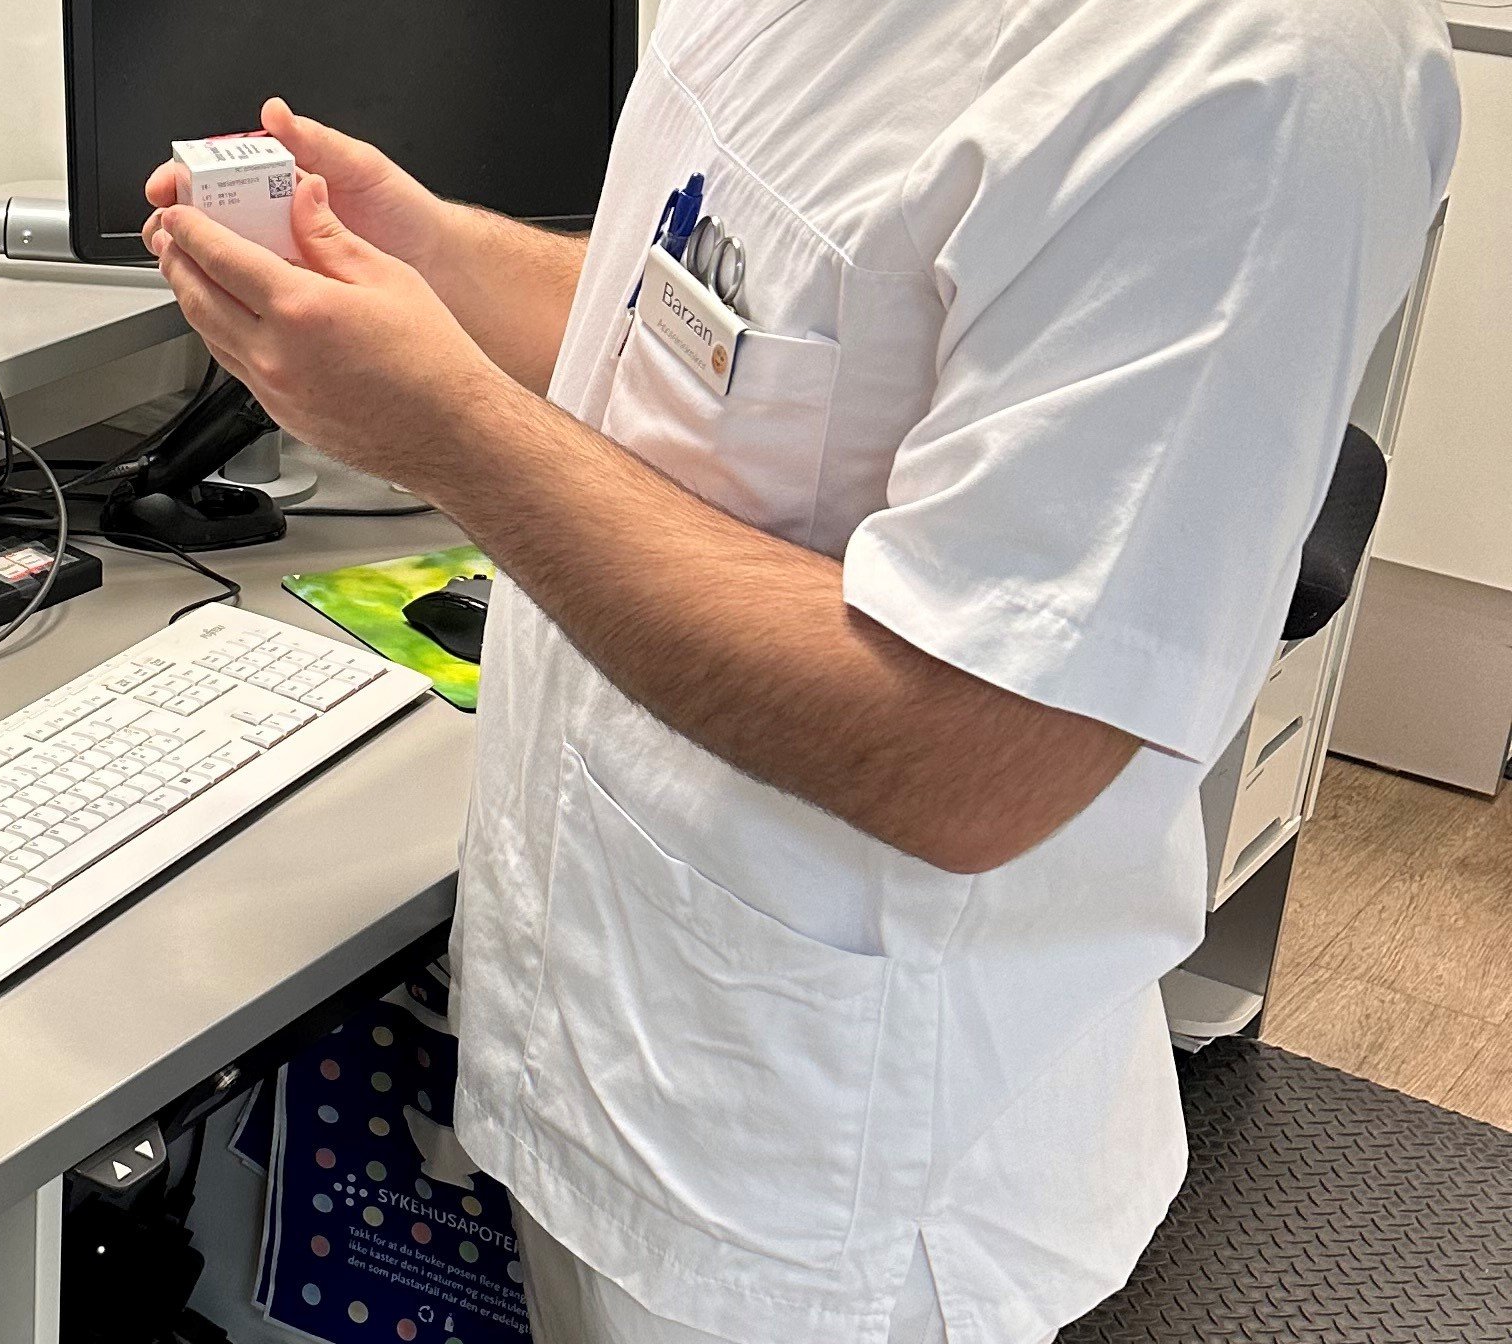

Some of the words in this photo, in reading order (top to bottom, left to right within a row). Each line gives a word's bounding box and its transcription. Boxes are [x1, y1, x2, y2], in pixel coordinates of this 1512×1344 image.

[661, 281, 713, 347] Barzan
[348, 1240, 368, 1254] ikke
[370, 1245, 399, 1265] kaster
[400, 1260, 419, 1274] den
[427, 1271, 464, 1290] naturen
[466, 1286, 478, 1300] og
[348, 1256, 365, 1269] den
[369, 1264, 389, 1278] som
[391, 1271, 439, 1296] plastavfall
[442, 1291, 458, 1304] når
[460, 1300, 478, 1313] den
[480, 1306, 491, 1317] er
[349, 1226, 370, 1241] Takk
[373, 1234, 386, 1246] for
[387, 1242, 398, 1251] at
[400, 1243, 413, 1256] du
[415, 1249, 446, 1268] bruker
[447, 1264, 477, 1282] posen
[479, 1272, 500, 1292] flere
